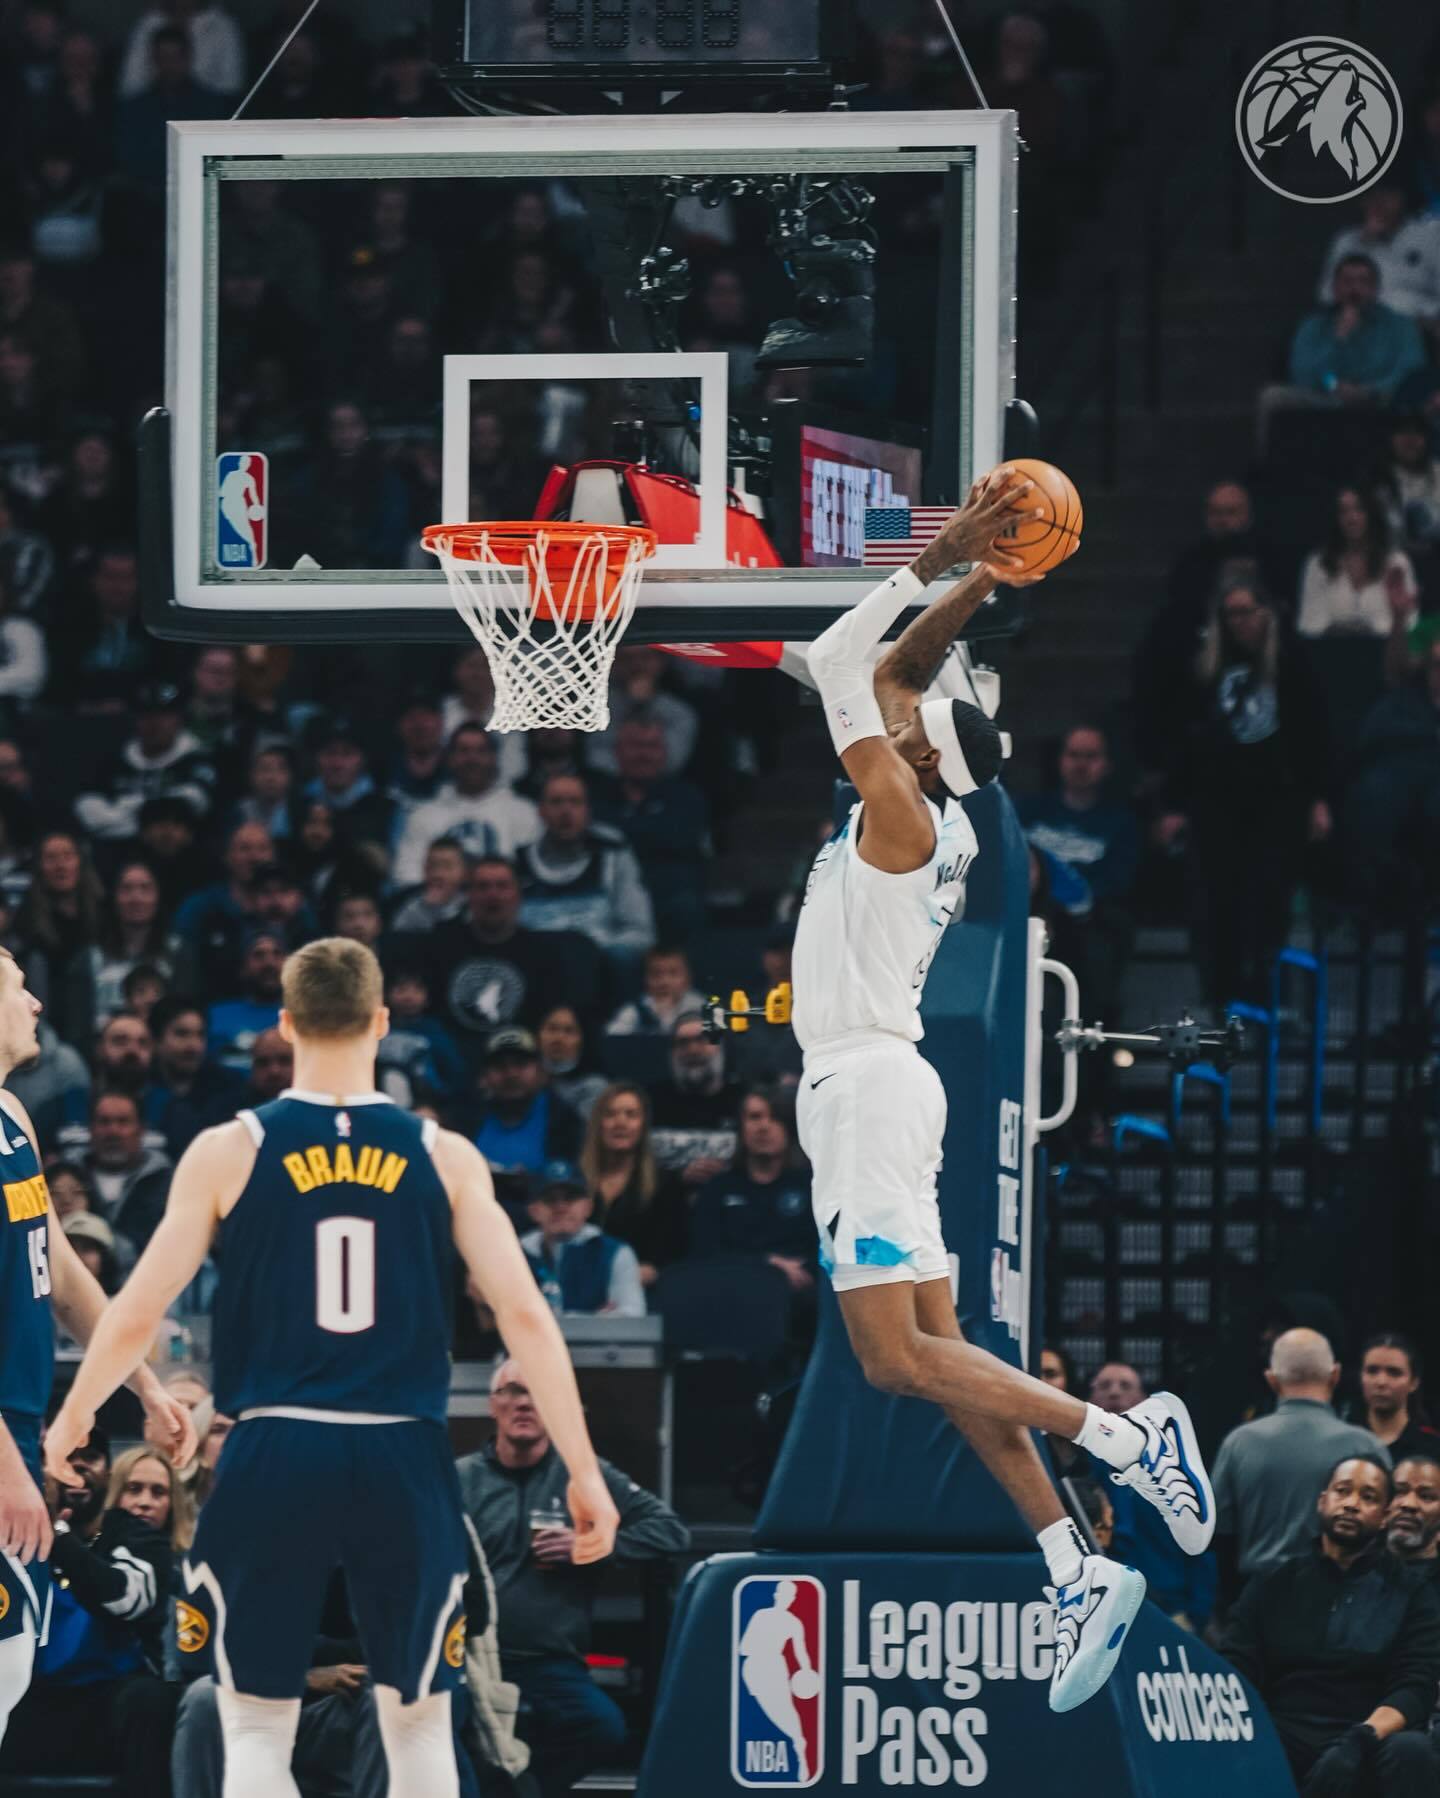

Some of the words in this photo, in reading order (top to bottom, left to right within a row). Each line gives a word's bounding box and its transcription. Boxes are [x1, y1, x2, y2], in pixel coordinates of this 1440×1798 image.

[282, 1143, 409, 1194] BRAUN
[316, 1215, 376, 1334] 0
[843, 1579, 1059, 1700] League
[841, 1685, 988, 1787] Pass
[1137, 1645, 1254, 1742] coinbase
[745, 1740, 790, 1773] NBA
